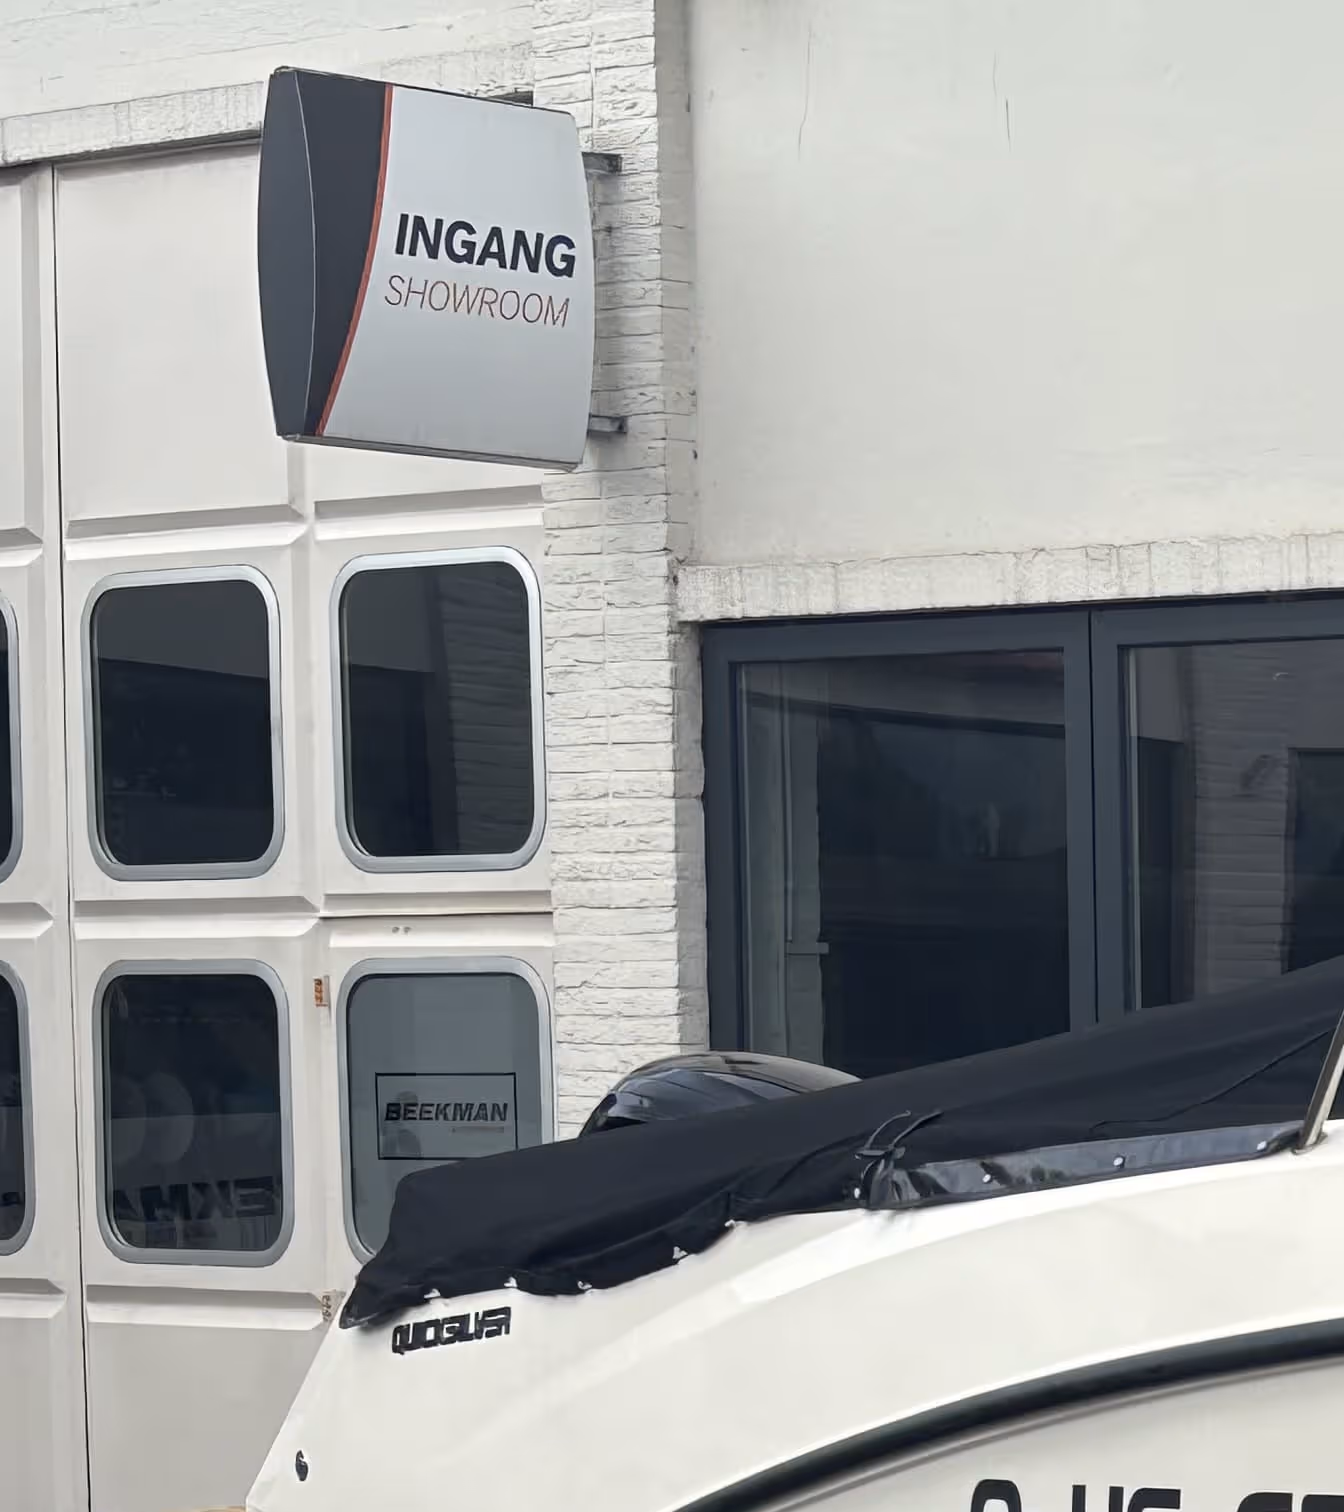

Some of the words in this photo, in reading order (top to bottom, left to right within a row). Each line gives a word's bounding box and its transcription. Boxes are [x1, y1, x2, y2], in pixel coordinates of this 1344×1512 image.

[394, 212, 577, 278] INGANG
[384, 274, 572, 328] SHOWROOM
[384, 1102, 508, 1122] BEEKMAN
